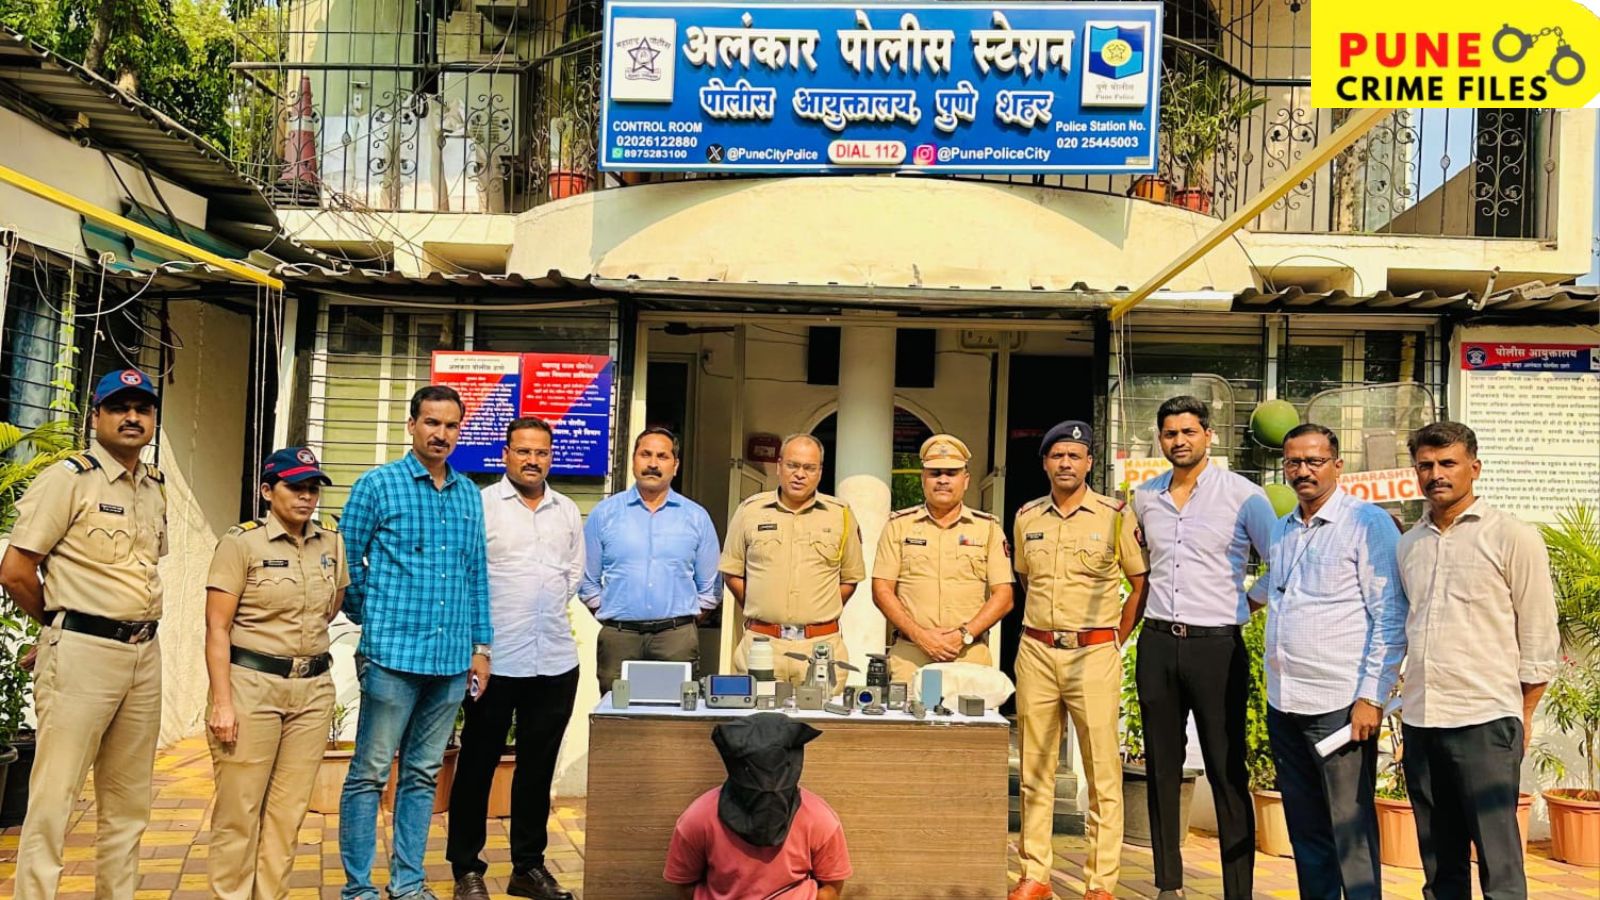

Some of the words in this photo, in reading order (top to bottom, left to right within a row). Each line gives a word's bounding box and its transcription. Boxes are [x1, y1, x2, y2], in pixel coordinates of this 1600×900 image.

[682, 12, 820, 71] अलंकार
[836, 9, 955, 74] पोलीस
[970, 10, 1075, 76] स्टेशन
[699, 78, 777, 120] पोलीस
[792, 87, 921, 131] आयुक्तालय,
[935, 80, 979, 132] पुणे
[996, 90, 1055, 128] शहर
[613, 120, 666, 132] CONTROL
[669, 121, 703, 133] ROOM
[1055, 121, 1087, 132] Police
[1089, 119, 1126, 132] Station
[1129, 119, 1146, 131] No.
[616, 135, 698, 148] 02026122880
[1056, 137, 1078, 149] 020
[1081, 136, 1139, 148] 25445003
[624, 149, 688, 159] 8975283100
[727, 148, 819, 162] @PuneCityPolice
[835, 144, 869, 159] DIAL
[875, 144, 899, 158] 112
[937, 147, 1051, 162] @PunePoliceCity
[1496, 345, 1525, 357] पोलीस
[1339, 470, 1416, 483] AHARASHT
